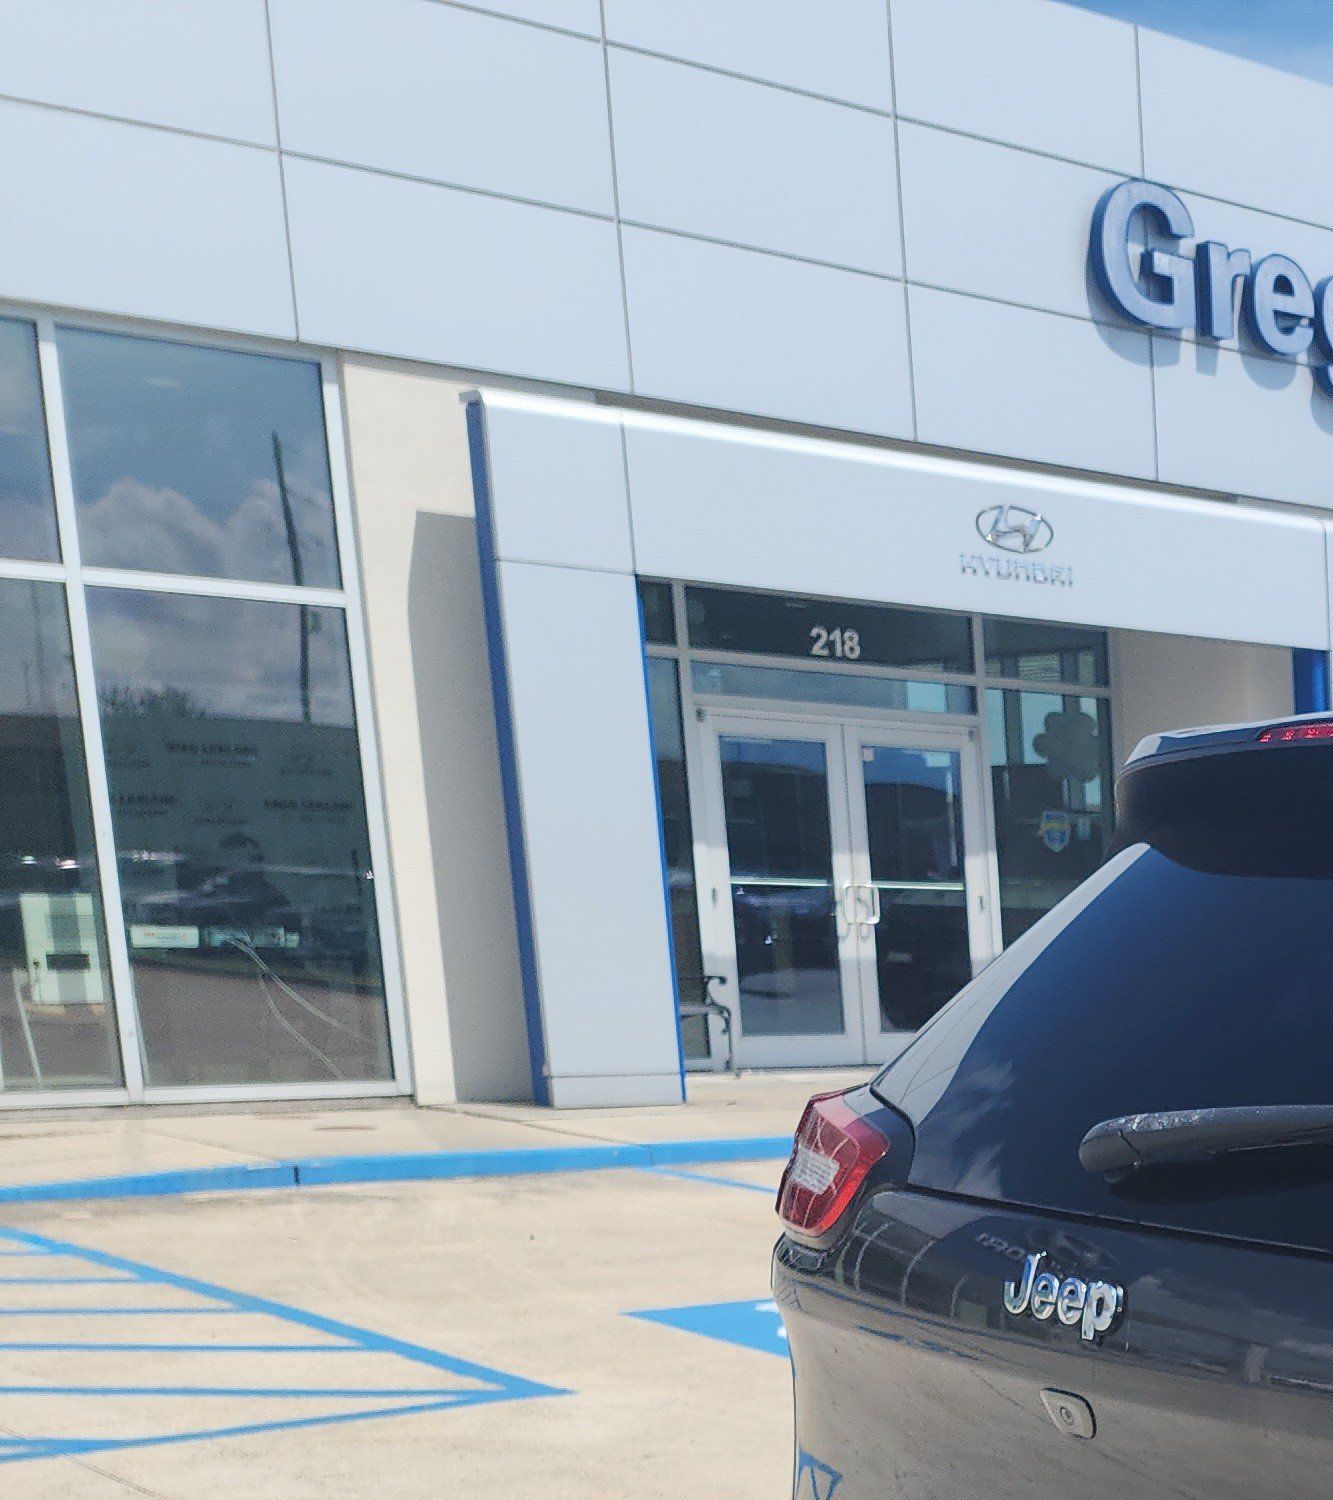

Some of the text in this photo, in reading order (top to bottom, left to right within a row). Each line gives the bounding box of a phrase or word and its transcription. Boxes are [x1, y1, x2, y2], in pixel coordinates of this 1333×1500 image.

[960, 552, 1073, 588] HYUNDAI
[809, 626, 860, 660] 218
[1004, 1251, 1119, 1341] Jeep
